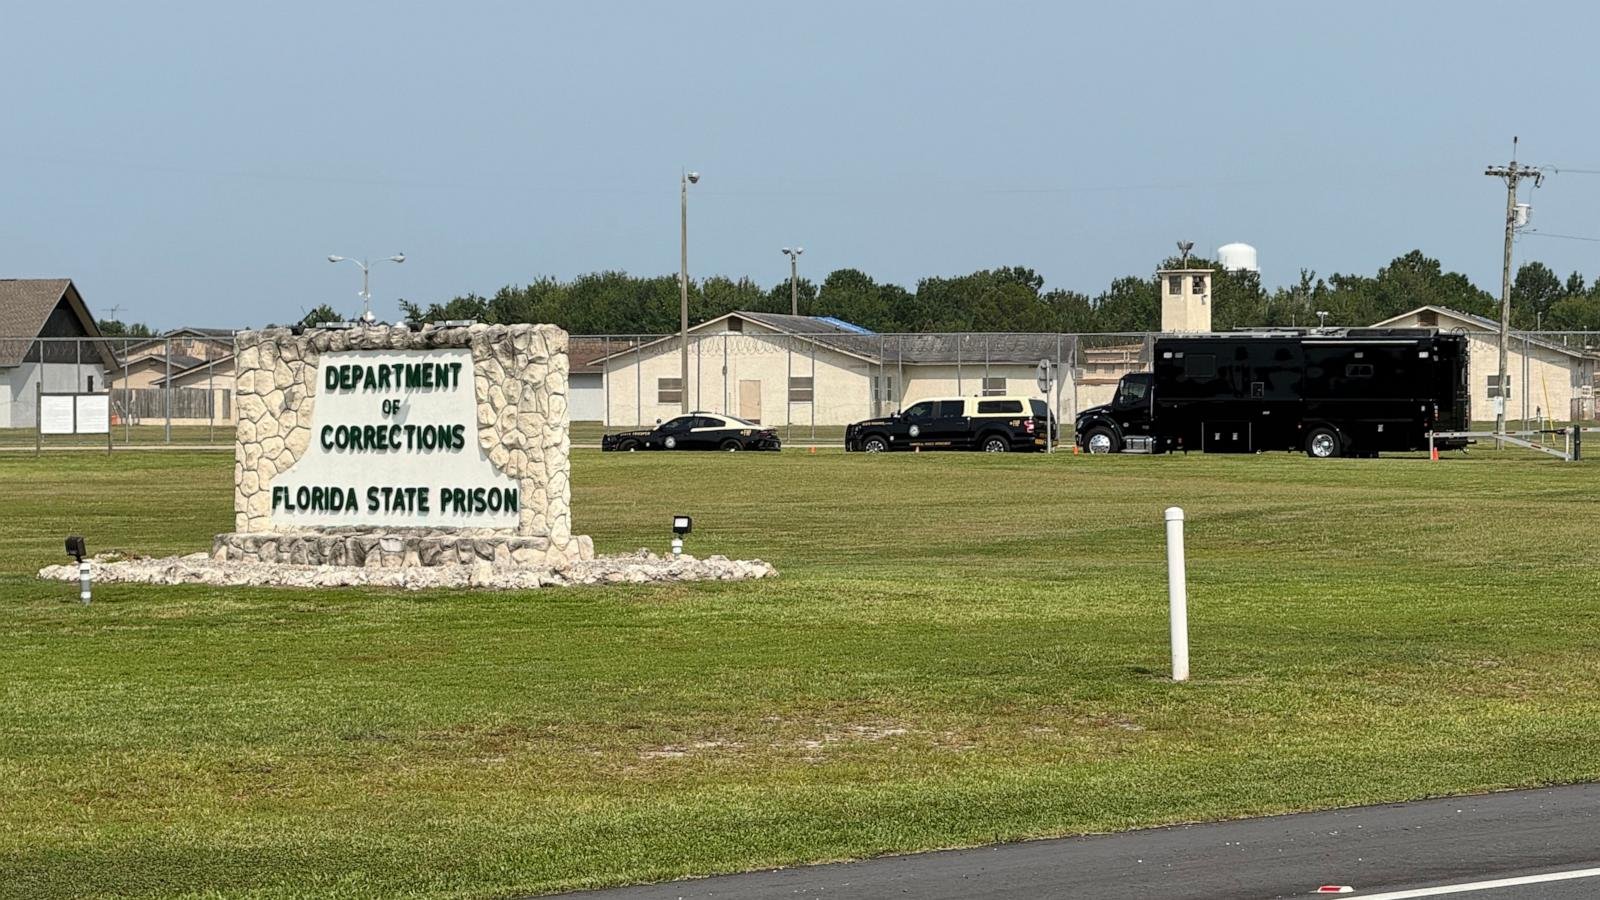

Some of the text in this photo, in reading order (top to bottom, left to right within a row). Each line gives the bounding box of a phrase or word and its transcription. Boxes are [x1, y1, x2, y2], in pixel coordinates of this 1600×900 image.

[326, 362, 462, 390] DEPARTMENT
[382, 399, 400, 415] OF
[321, 425, 465, 450] CORRECTIONS
[272, 486, 518, 513] FLORIDA STATE PRISON
